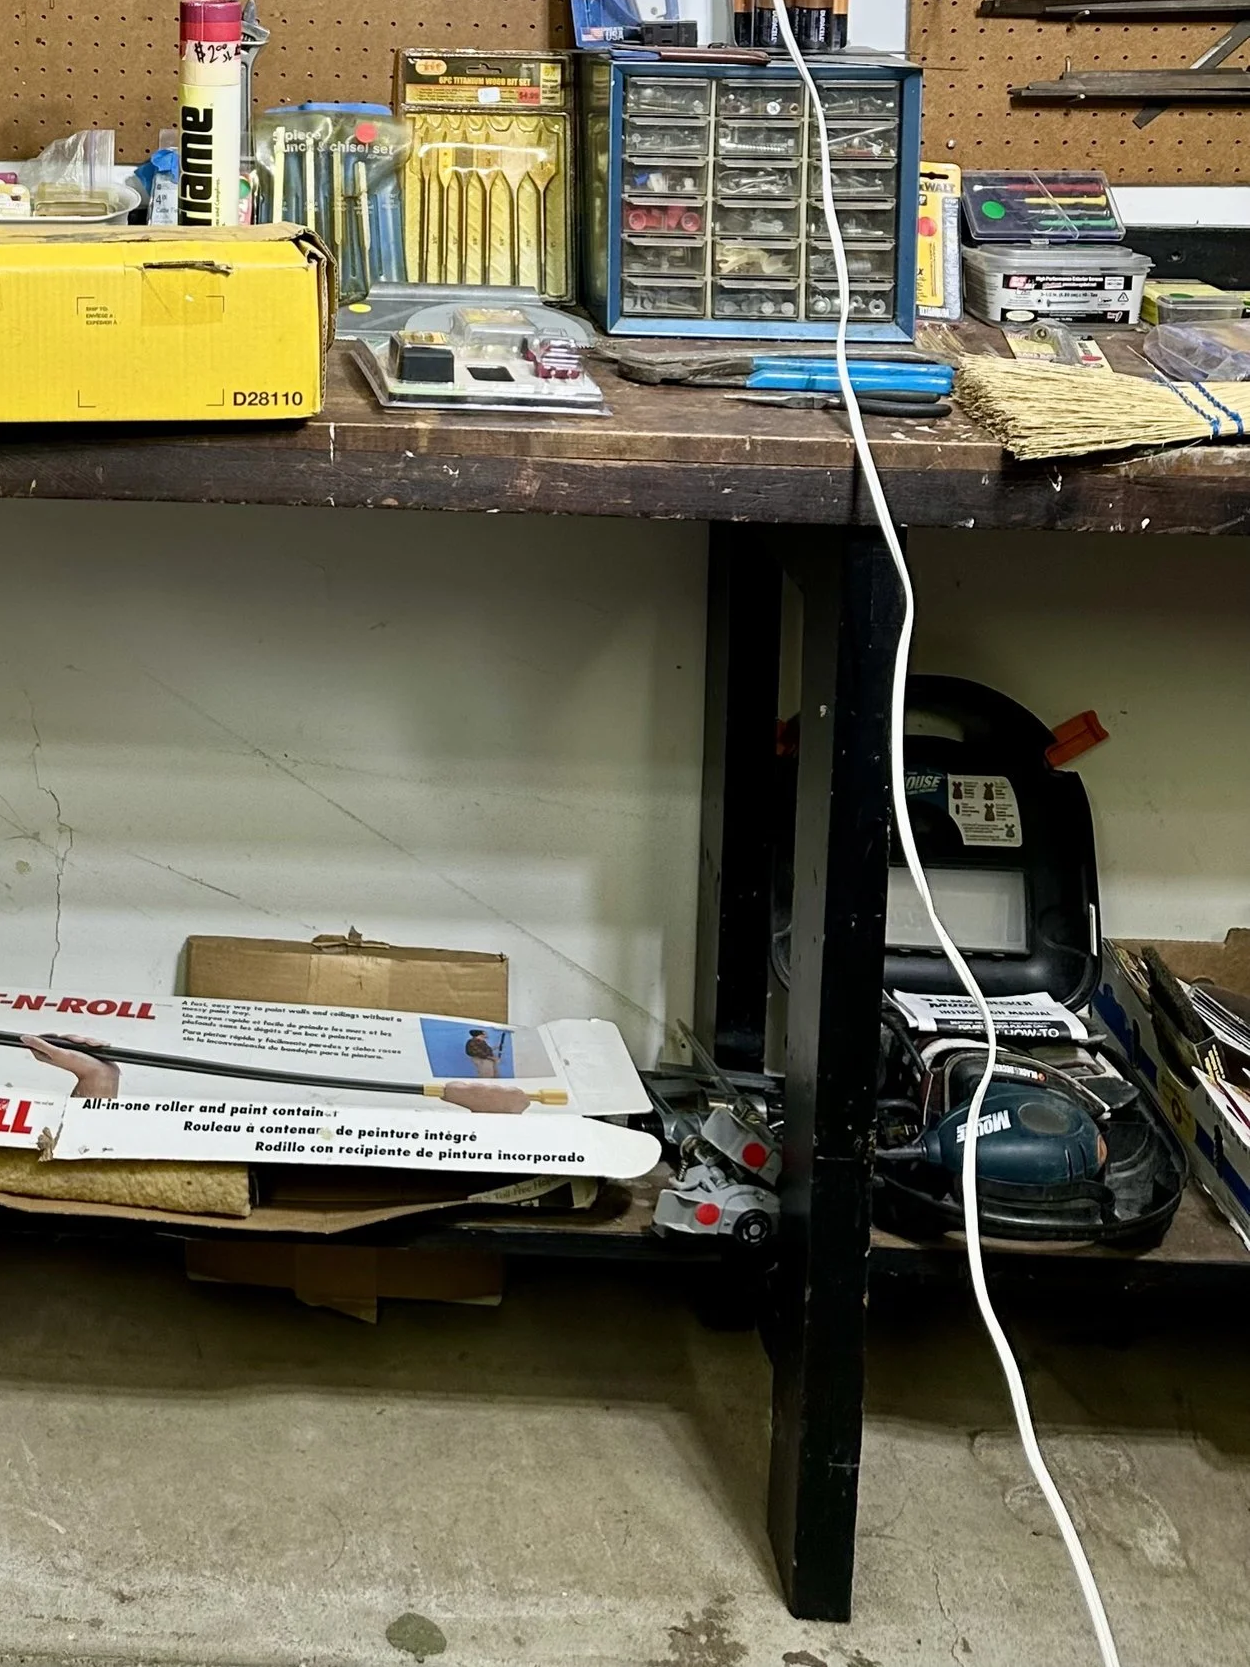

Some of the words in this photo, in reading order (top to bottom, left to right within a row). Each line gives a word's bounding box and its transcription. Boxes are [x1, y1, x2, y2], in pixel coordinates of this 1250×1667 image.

[454, 77, 484, 85] TITANIUM
[486, 78, 505, 86] WOOD
[285, 130, 321, 142] piece
[330, 142, 368, 152] chisel
[373, 145, 393, 154] set
[181, 105, 213, 226] flame
[233, 392, 303, 406] D28110
[904, 775, 943, 791] OUSE
[330, 1011, 359, 1019] ceilings
[362, 1014, 394, 1022] without
[182, 1019, 216, 1027] plafonds
[298, 1024, 329, 1032] peindre
[281, 1046, 317, 1055] bandejas
[308, 1042, 342, 1050] paredes
[82, 1098, 150, 1112] All-in-one
[155, 1101, 194, 1113] roller
[200, 1103, 225, 1114] and
[230, 1104, 268, 1117] paint
[184, 1121, 241, 1133] Rouleau
[246, 1123, 254, 1133] à
[336, 1125, 353, 1137] de
[358, 1127, 419, 1139] peinture
[425, 1129, 477, 1144] intégré
[956, 1110, 1012, 1144] MOUE
[255, 1141, 305, 1153] Rodillo
[310, 1145, 333, 1154] con
[339, 1145, 411, 1158] recipiente
[416, 1147, 433, 1158] de
[439, 1149, 493, 1161] pintura
[498, 1150, 585, 1164] incorporado
